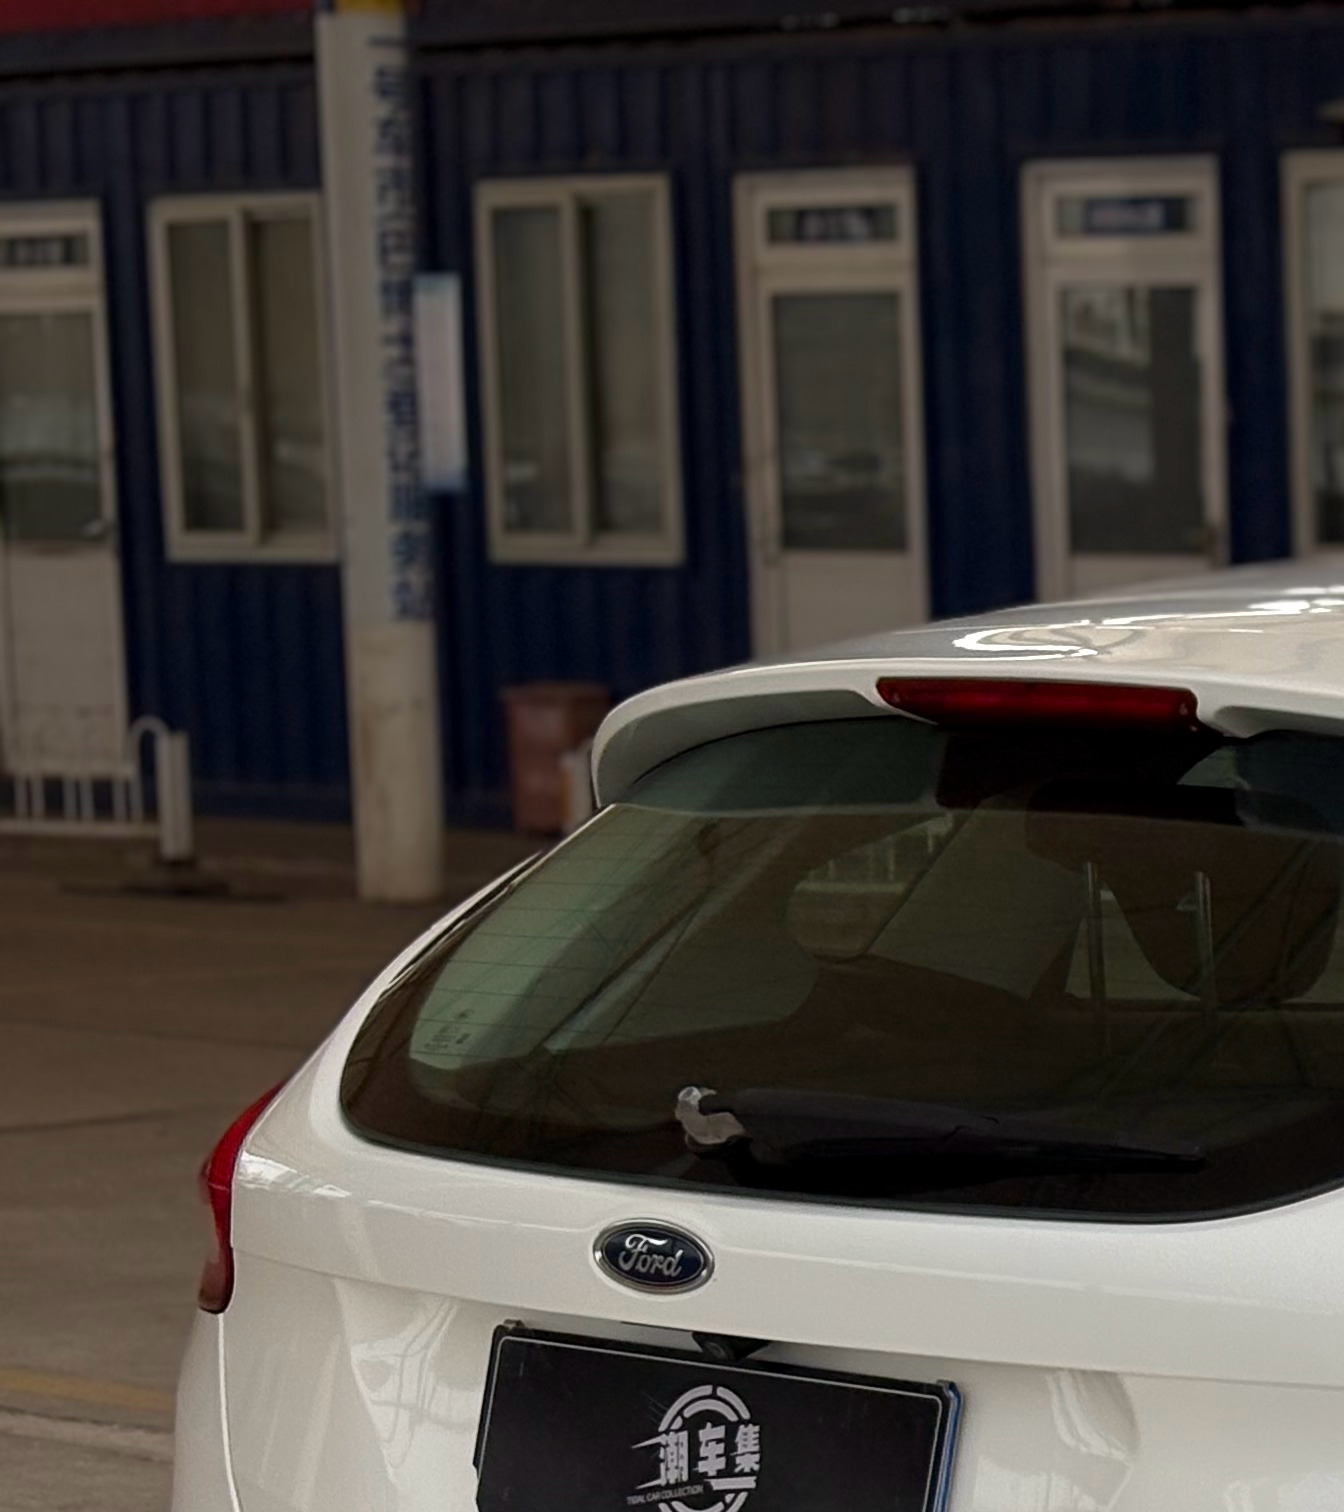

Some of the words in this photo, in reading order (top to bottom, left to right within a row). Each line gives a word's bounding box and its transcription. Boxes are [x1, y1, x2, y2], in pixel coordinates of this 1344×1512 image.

[618, 1233, 684, 1277] Ford
[658, 1421, 761, 1486] 潮车集
[646, 1491, 661, 1502] CAR
